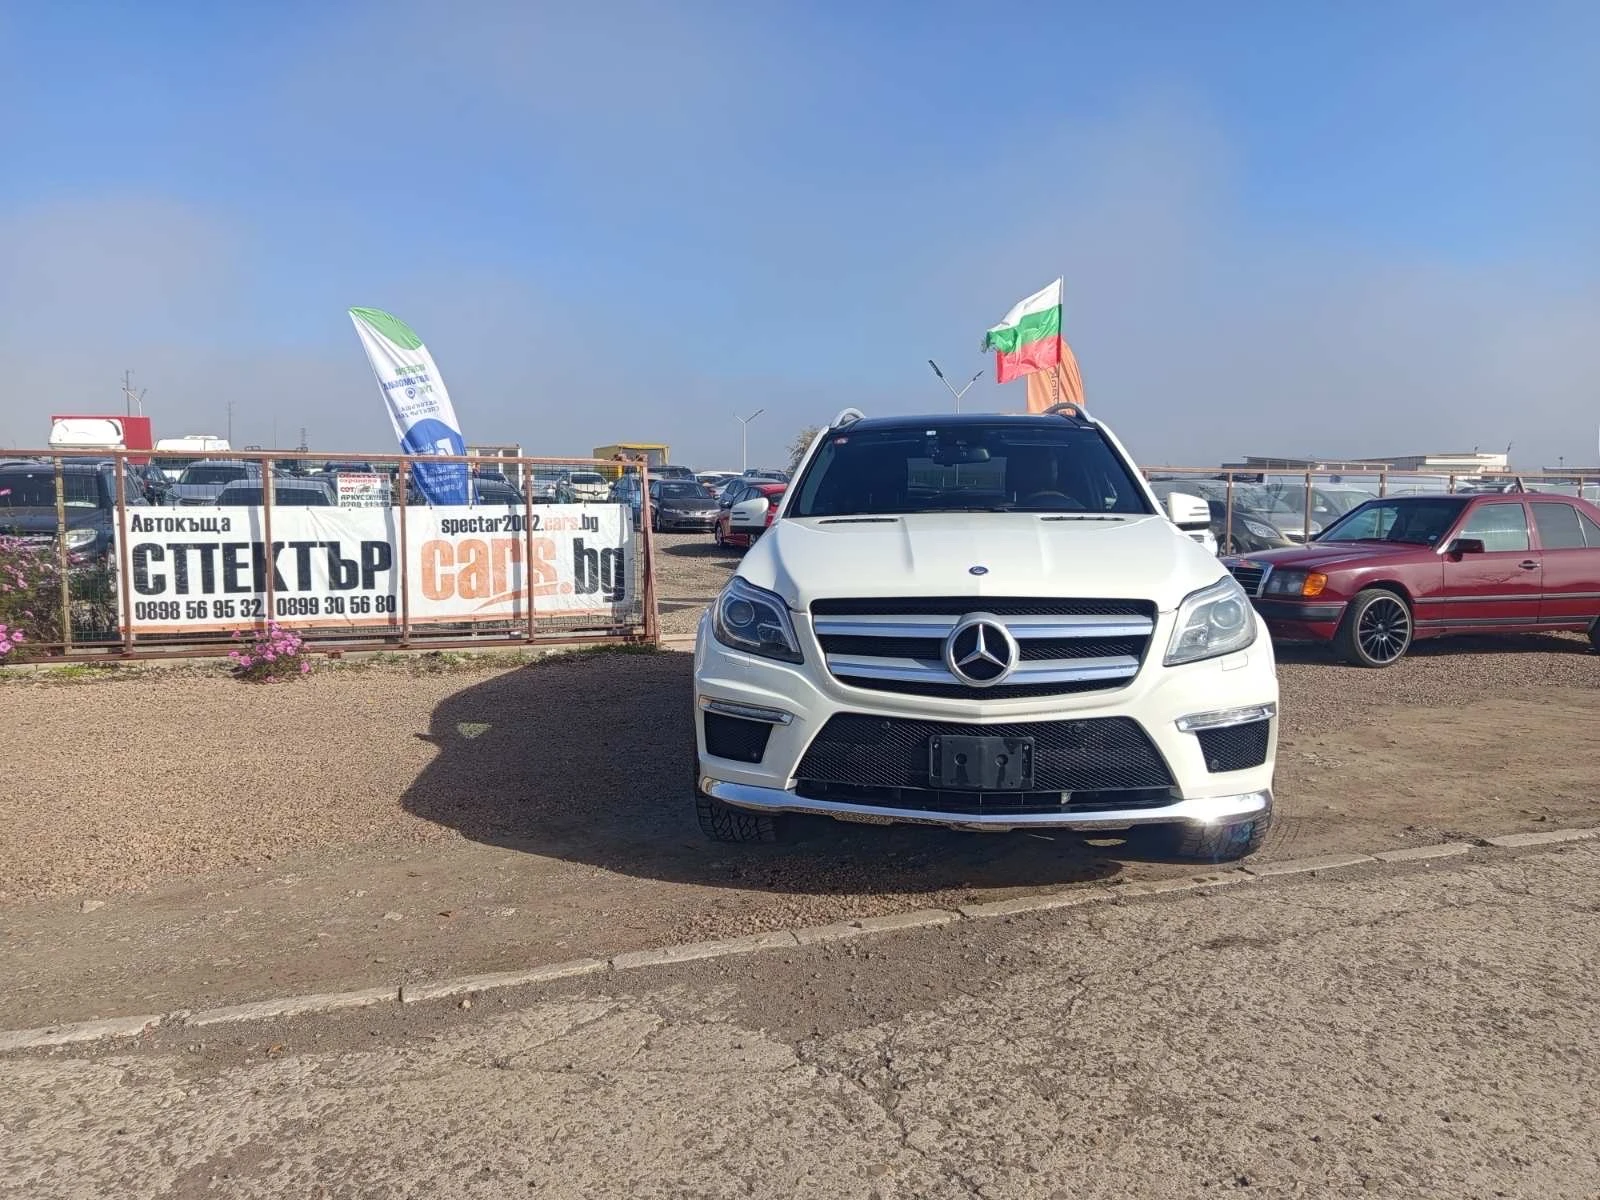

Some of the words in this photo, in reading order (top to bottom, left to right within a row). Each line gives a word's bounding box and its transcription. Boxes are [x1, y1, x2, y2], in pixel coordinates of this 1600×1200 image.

[131, 514, 231, 534] Автокъща
[441, 513, 599, 536] spectar2002.cars.bg
[132, 540, 392, 596] СПЕКТЪР
[421, 537, 625, 603] cars.bg
[135, 600, 181, 621] 0898
[186, 600, 208, 619] 56
[213, 599, 237, 618] 95
[276, 597, 319, 616] 0899
[324, 596, 345, 615] 30
[349, 595, 371, 614] 56
[375, 594, 397, 613] 80
